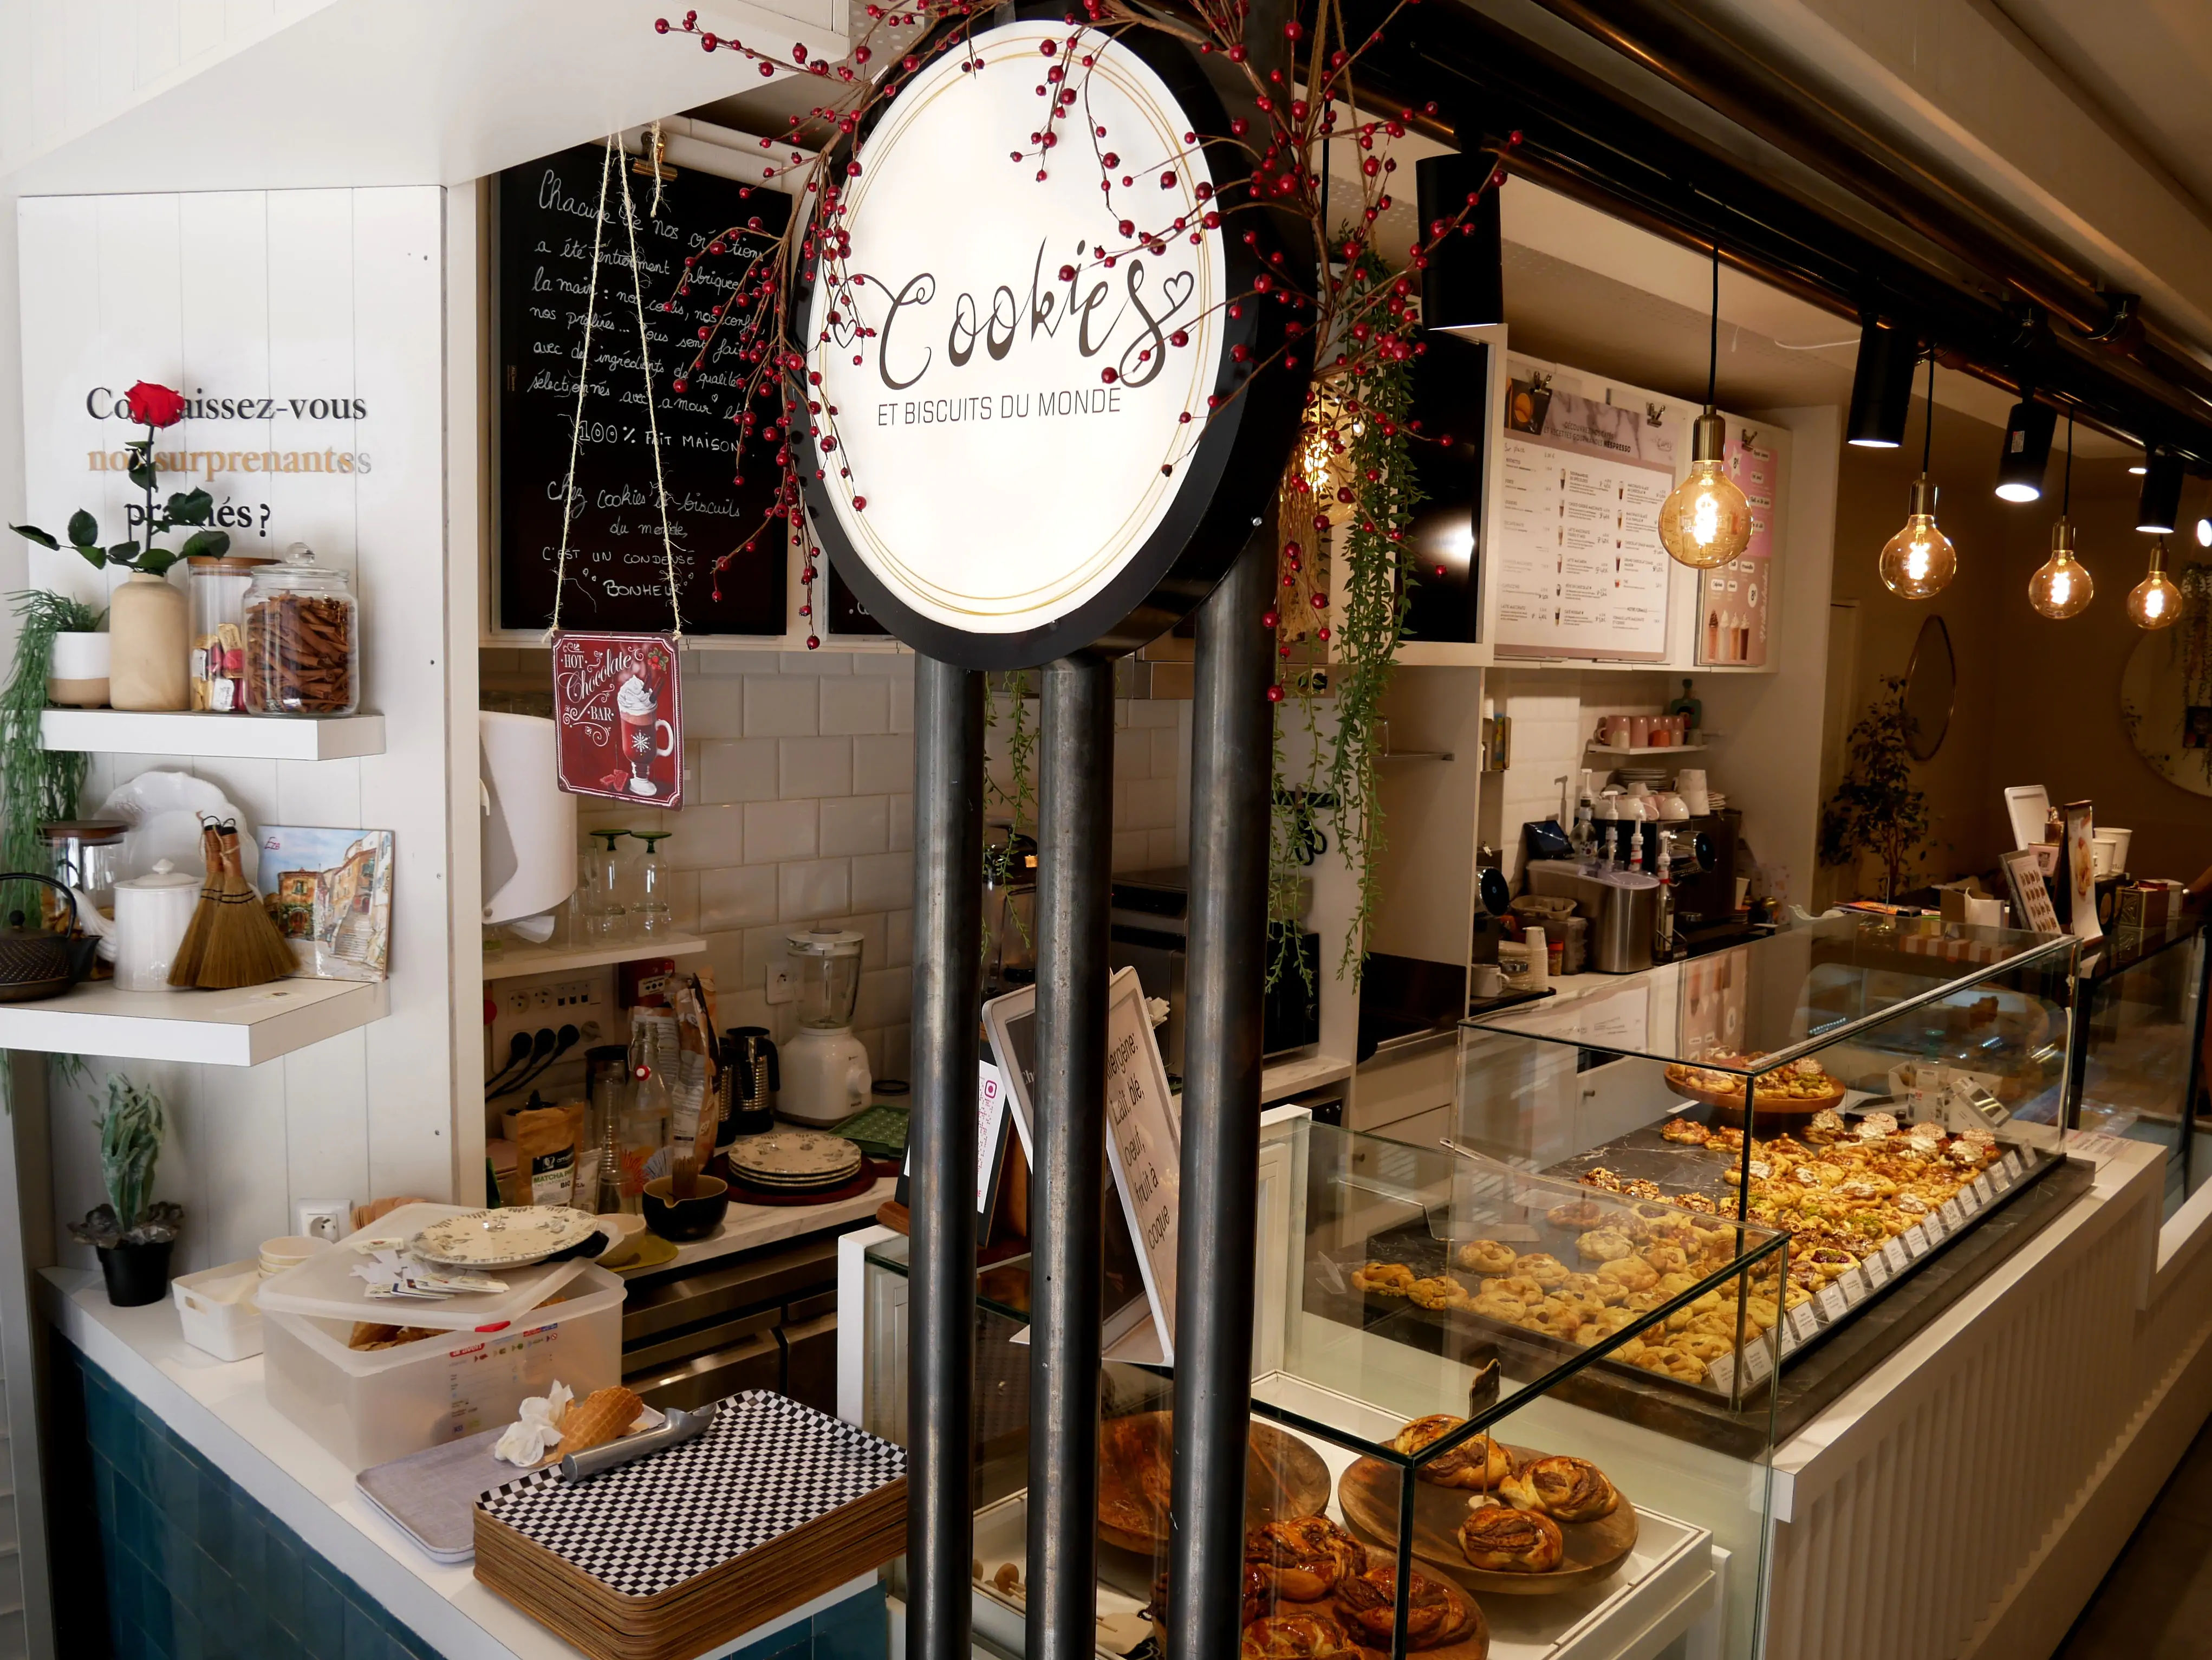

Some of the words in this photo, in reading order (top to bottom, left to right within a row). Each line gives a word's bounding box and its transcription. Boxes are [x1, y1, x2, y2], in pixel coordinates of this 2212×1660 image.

[534, 241, 551, 253] a
[559, 238, 588, 259] été
[531, 266, 553, 291] la
[645, 300, 689, 321] colis,
[529, 307, 556, 320] nos
[867, 235, 1175, 390] Cookies
[534, 341, 563, 355] avec
[86, 387, 367, 420] Coaissez-vous
[619, 391, 649, 405] avec
[878, 403, 899, 426] ET
[905, 395, 992, 424] BISCUITS
[1001, 393, 1029, 419] DU
[1038, 387, 1122, 417] MONDE
[609, 515, 629, 536] du
[558, 649, 633, 703] Chocolate
[564, 654, 584, 669] HOT
[591, 706, 611, 721] BAR
[1107, 1033, 1138, 1080] llergène:
[1127, 1073, 1146, 1107] blé,
[534, 1171, 564, 1184] MATCHA
[1134, 1170, 1153, 1209] fruit
[1148, 1205, 1170, 1250] coque
